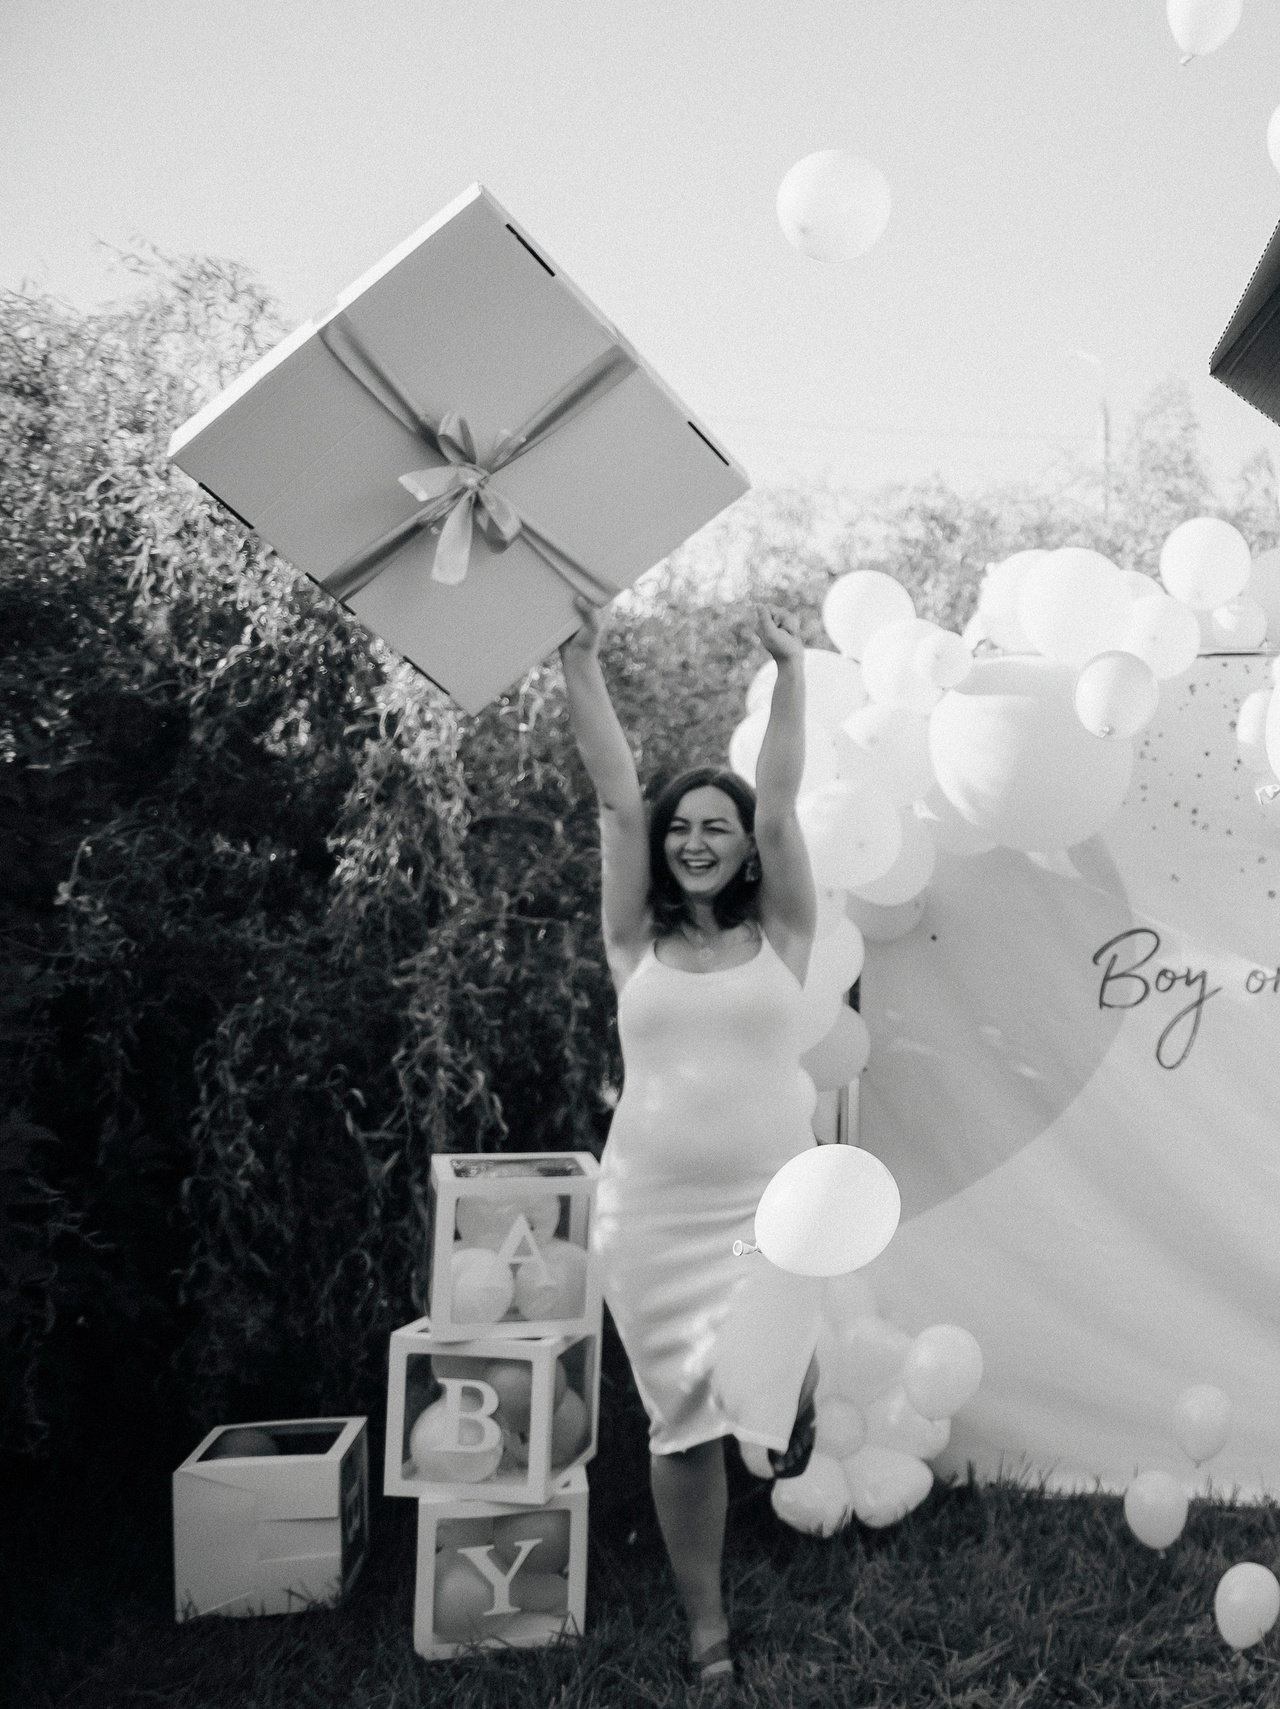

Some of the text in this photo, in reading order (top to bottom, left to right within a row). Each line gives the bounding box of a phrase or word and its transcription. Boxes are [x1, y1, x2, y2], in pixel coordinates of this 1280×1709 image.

[1092, 927, 1222, 1069] Boy
[480, 1213, 558, 1288] A
[433, 1377, 502, 1454] B
[457, 1537, 544, 1617] Y
